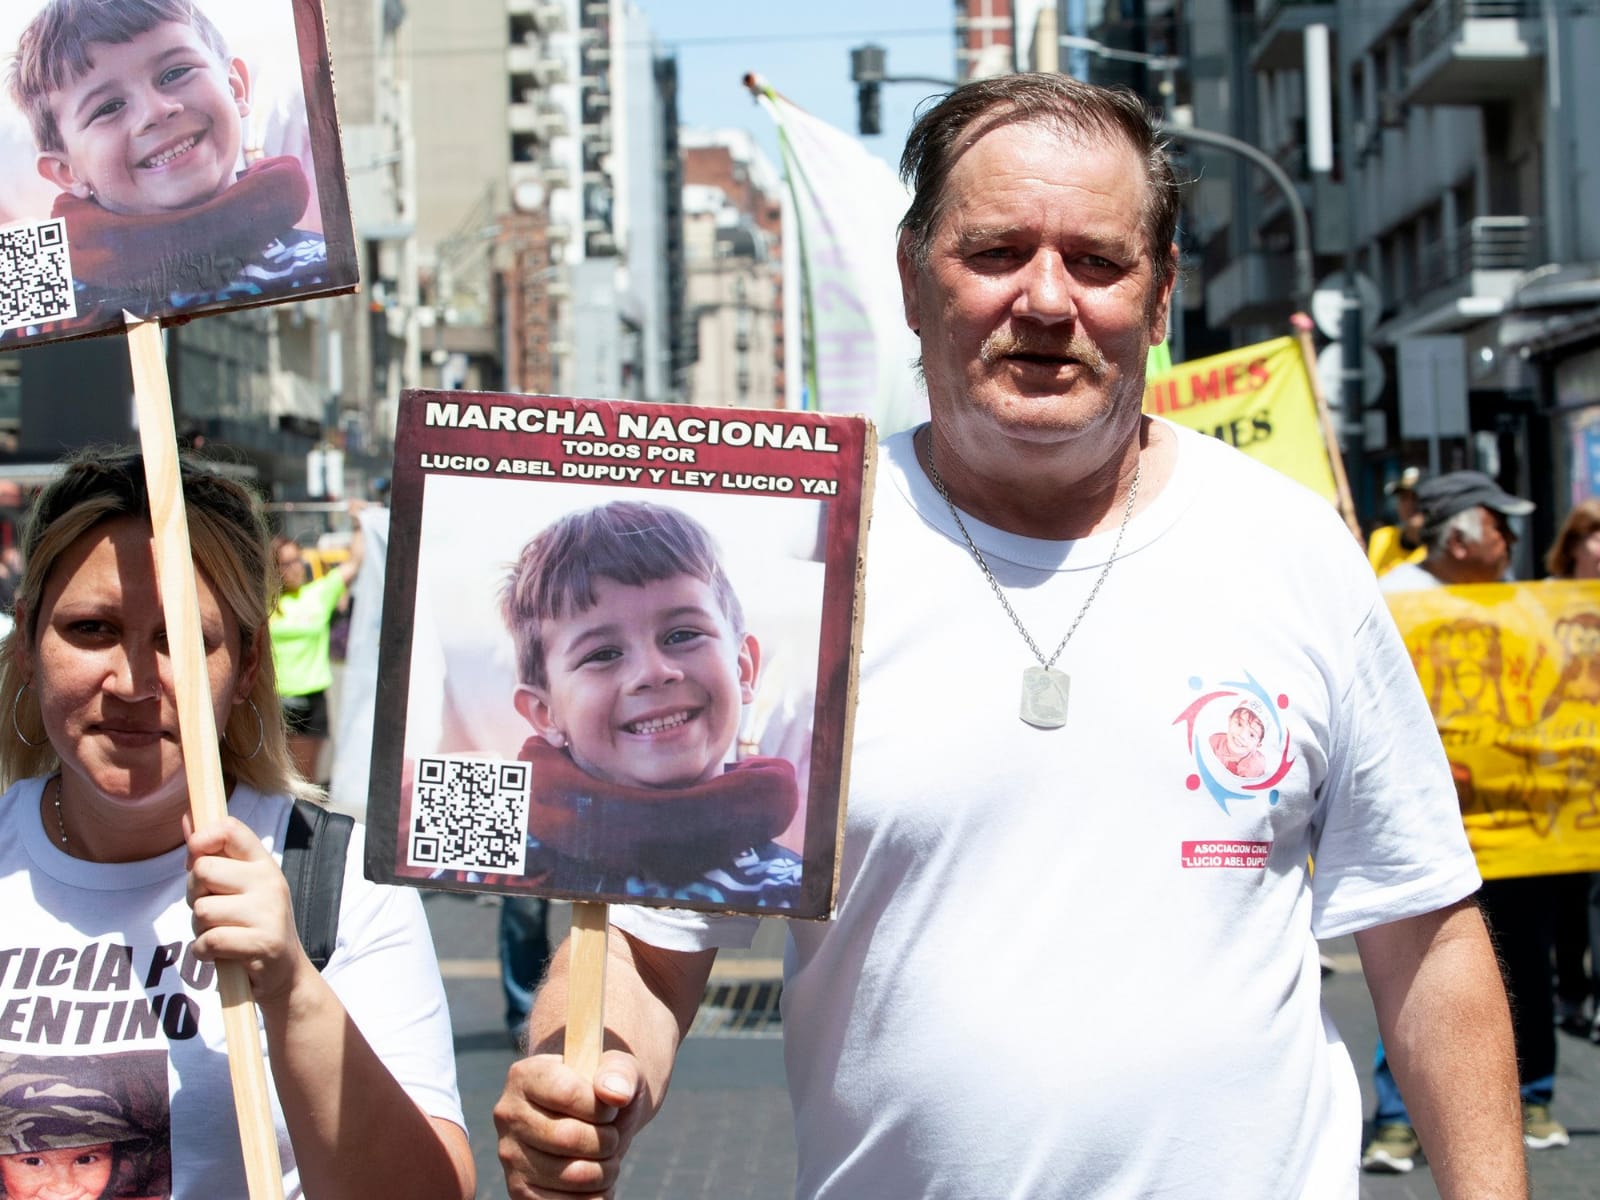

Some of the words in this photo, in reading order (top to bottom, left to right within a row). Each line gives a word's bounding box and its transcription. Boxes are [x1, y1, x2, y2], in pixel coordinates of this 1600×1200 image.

[424, 401, 606, 437] MARCHA
[617, 413, 839, 452] NACIONAL
[562, 440, 641, 459] TODOS
[647, 446, 696, 463] POR
[420, 454, 490, 472] LUCIO
[495, 458, 556, 476] ABEL
[562, 463, 642, 482] DUPUY
[649, 468, 665, 483] Y
[671, 470, 717, 487] LEY
[722, 473, 794, 492] LUCIO
[799, 478, 839, 495] YA!
[1194, 844, 1251, 854] ASOCIACION
[1251, 845, 1268, 854] CIVIL
[1224, 857, 1245, 866] ABEL
[144, 941, 217, 991] PO
